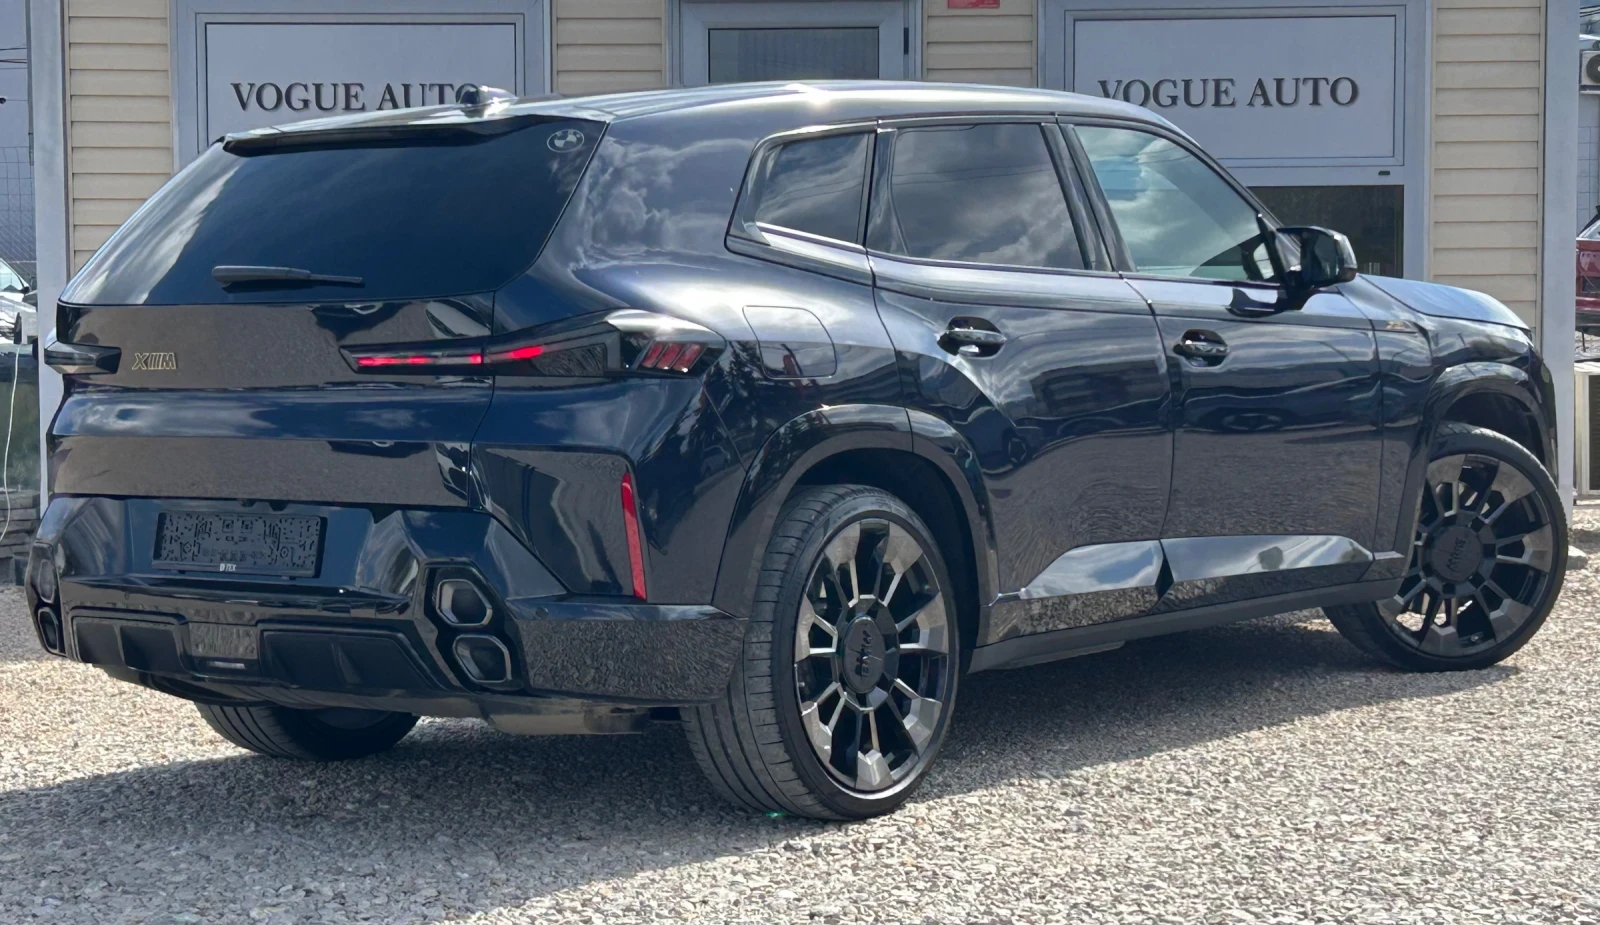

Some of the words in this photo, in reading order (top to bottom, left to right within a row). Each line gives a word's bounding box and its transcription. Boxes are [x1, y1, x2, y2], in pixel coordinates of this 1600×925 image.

[231, 82, 366, 111] VOGUE
[1098, 78, 1236, 107] VOGUE
[1247, 77, 1359, 107] AUTO
